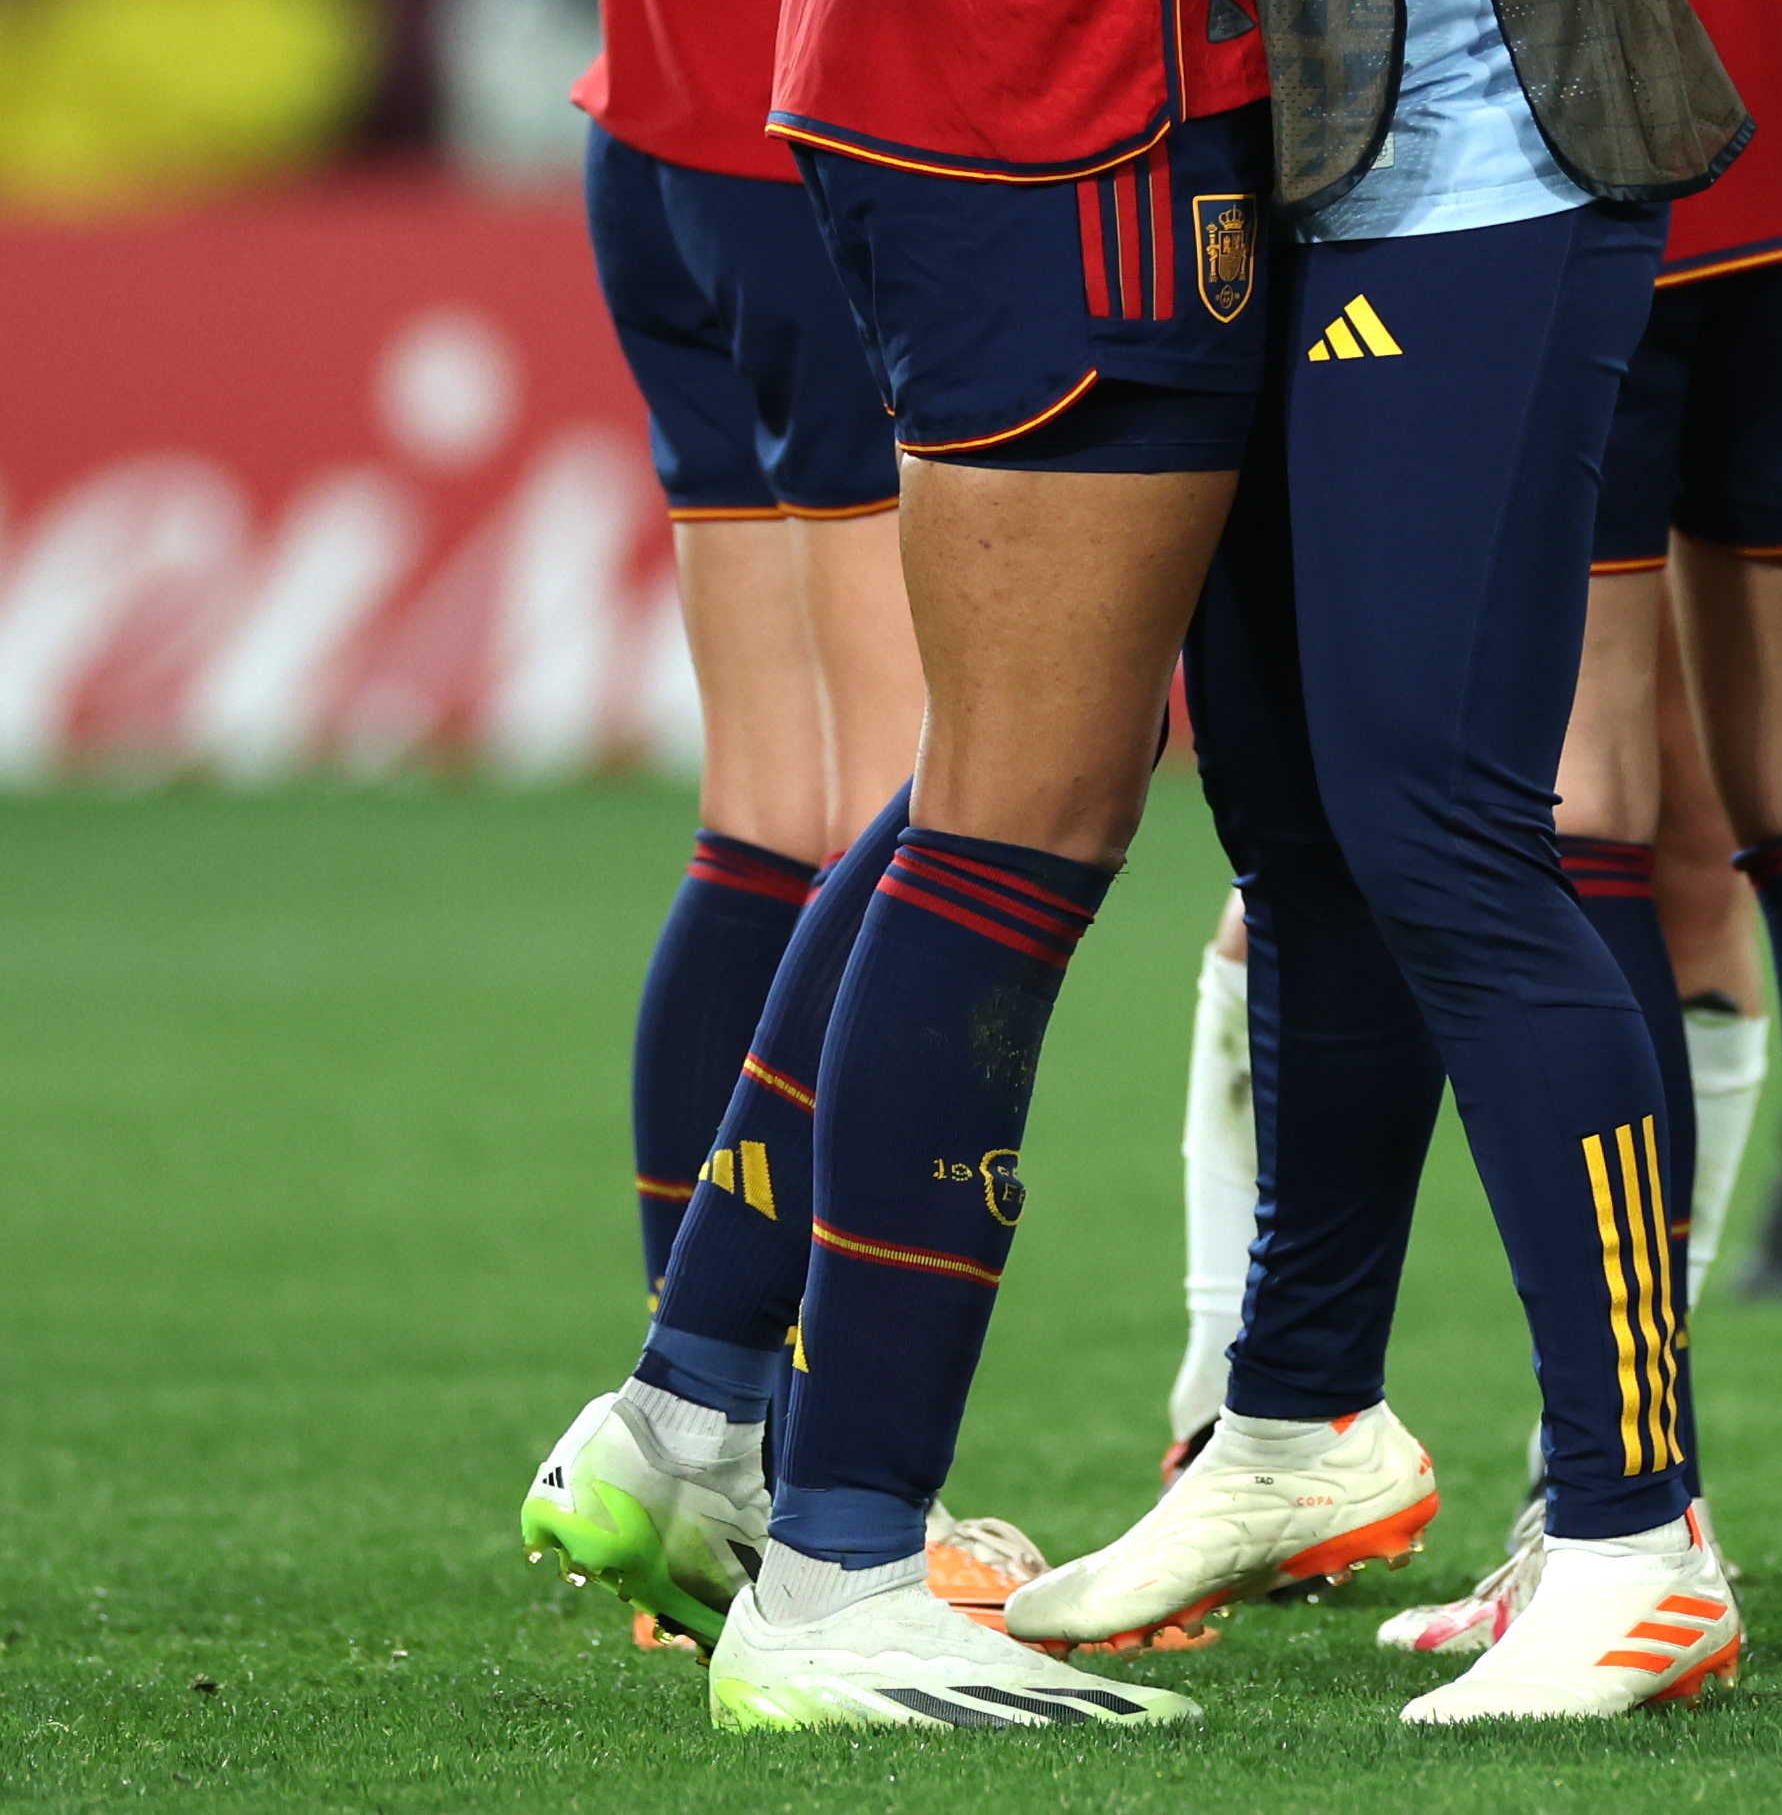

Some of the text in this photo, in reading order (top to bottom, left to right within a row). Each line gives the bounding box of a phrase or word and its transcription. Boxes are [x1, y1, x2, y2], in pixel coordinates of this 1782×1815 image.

[932, 1158, 974, 1183] 19
[1254, 1476, 1274, 1485] TAD
[1296, 1495, 1335, 1507] COPA
